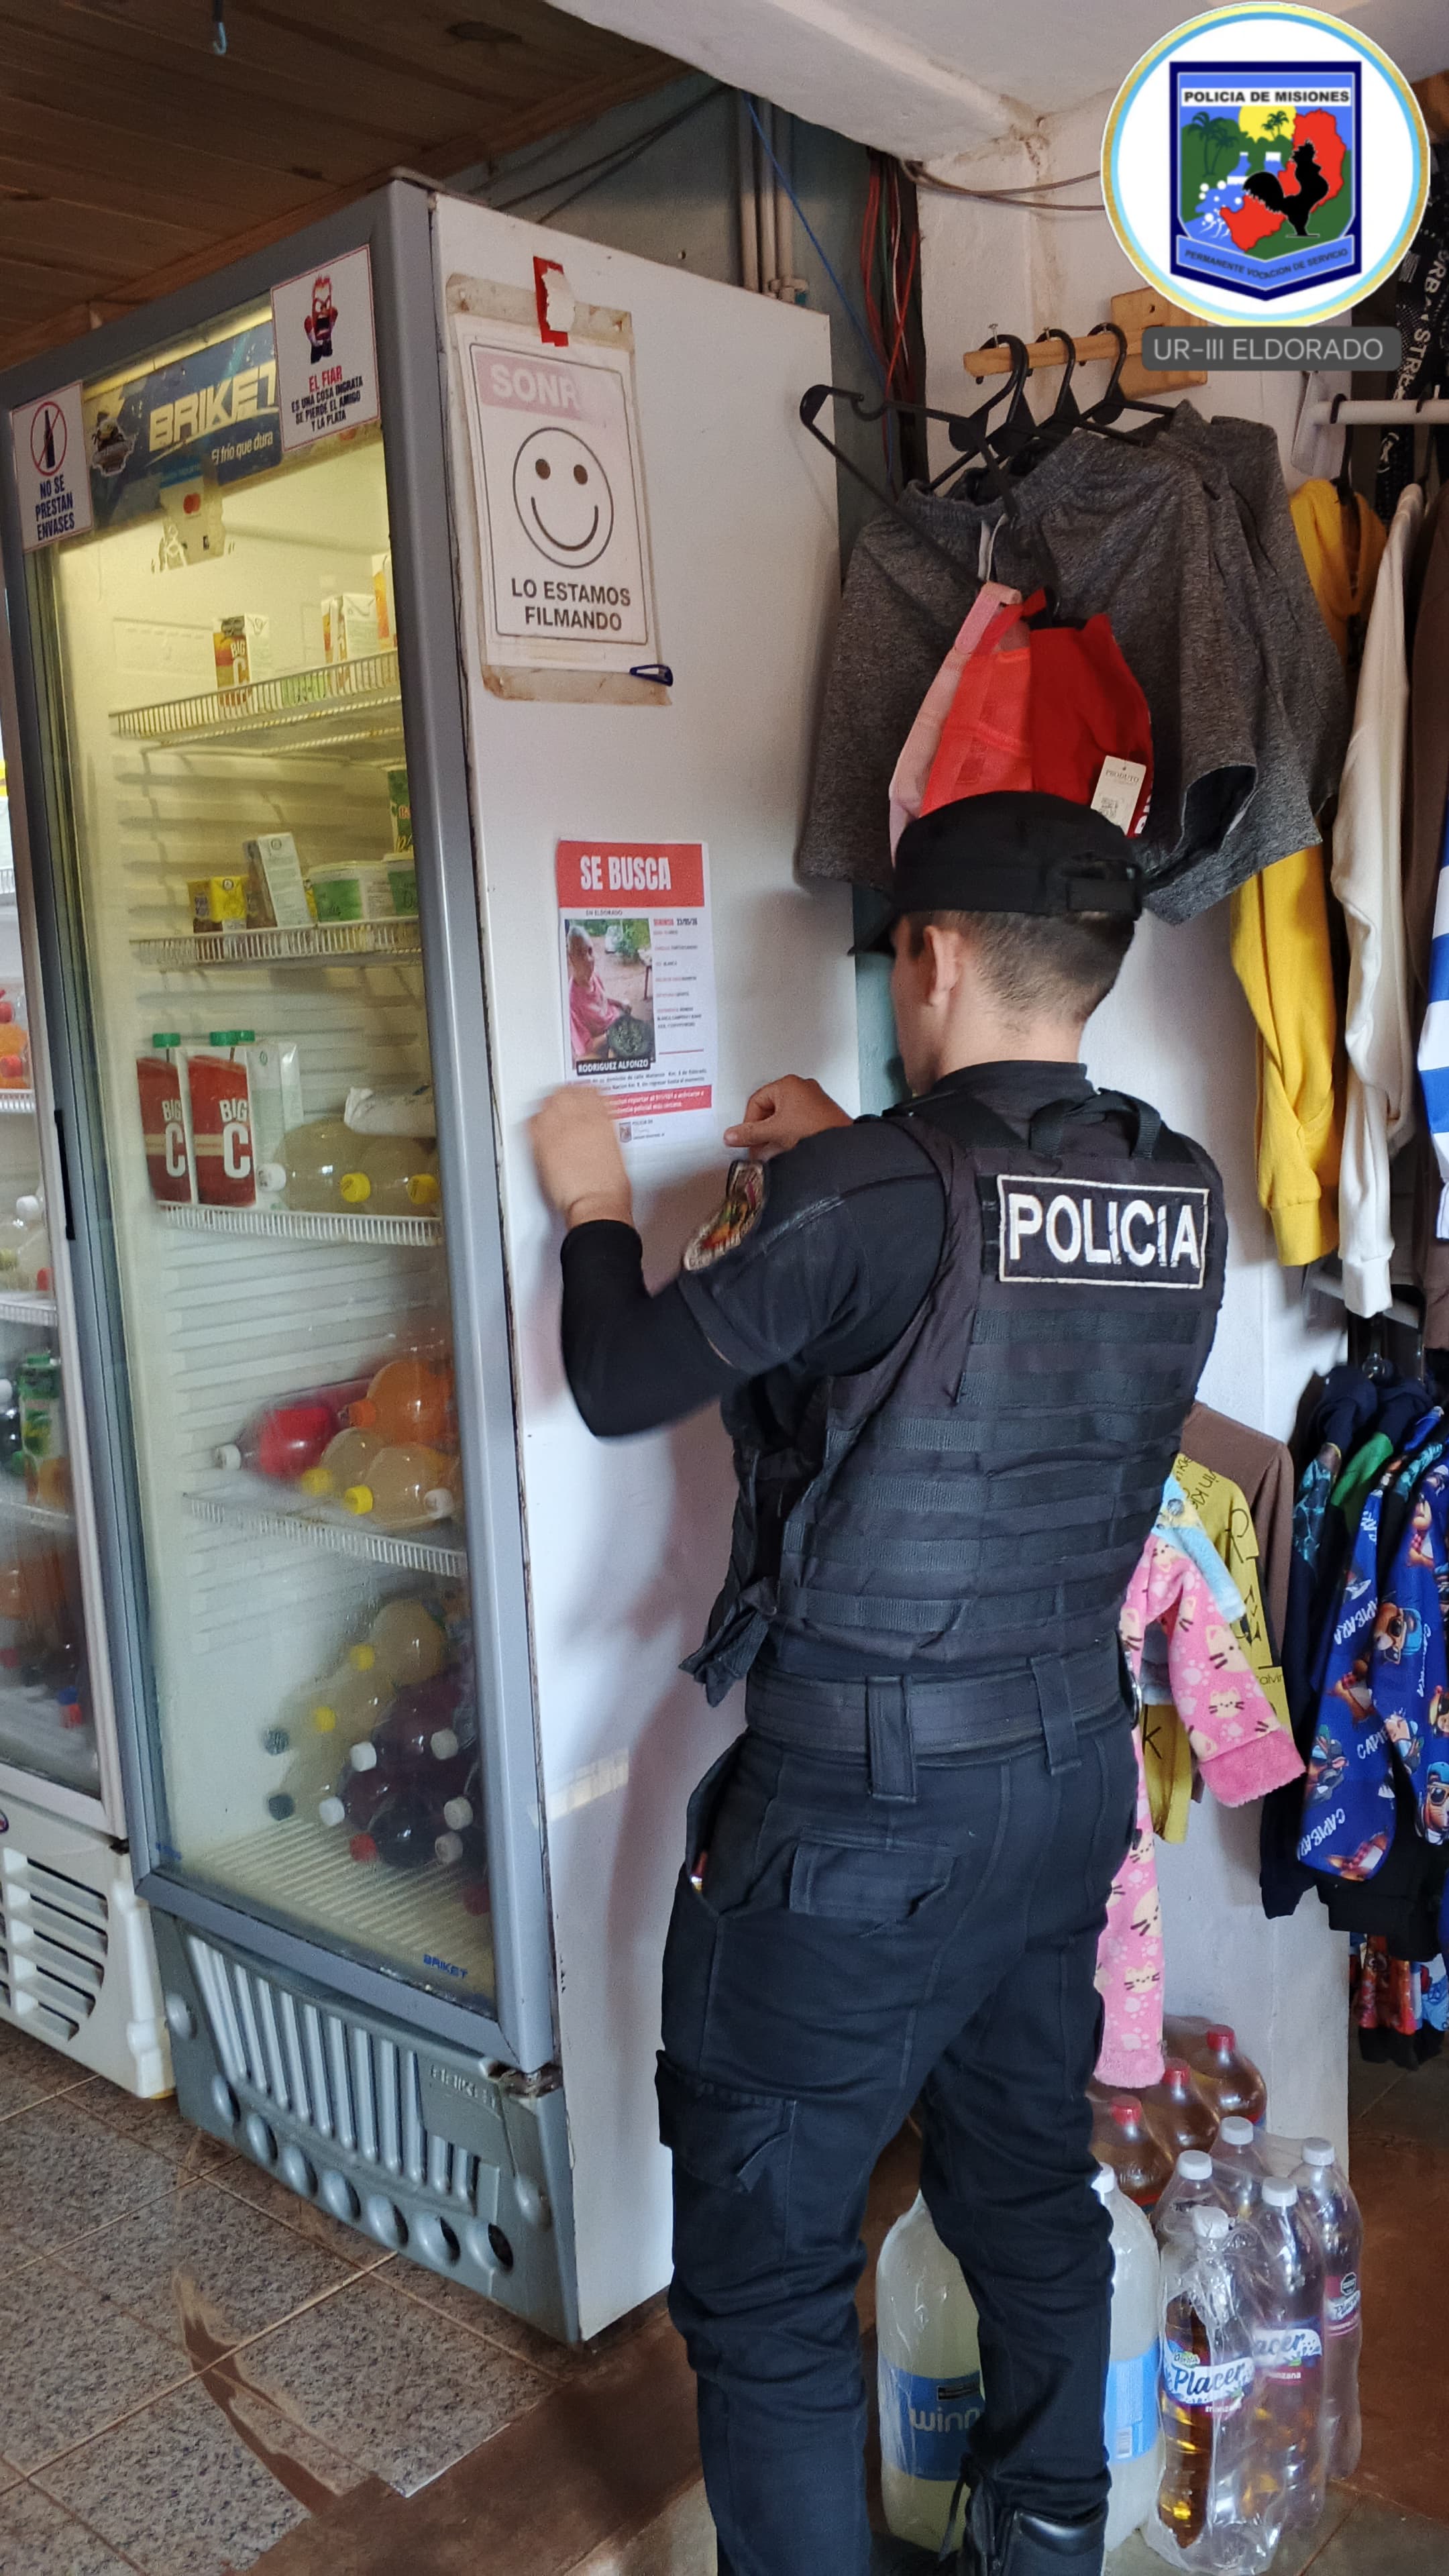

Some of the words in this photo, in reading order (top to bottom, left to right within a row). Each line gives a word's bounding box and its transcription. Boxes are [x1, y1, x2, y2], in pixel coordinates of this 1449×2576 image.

[309, 374, 320, 392] EL
[321, 365, 343, 387] FIAR
[149, 360, 277, 452] BRIKET
[291, 400, 300, 413] ES
[301, 394, 315, 409] UNA
[316, 387, 334, 404] COSA
[335, 376, 364, 394] INGRATA
[295, 412, 304, 425] SE
[305, 402, 328, 423] PIERDE
[329, 400, 337, 412] EL
[339, 390, 361, 407] AMIGO
[311, 421, 315, 432] Y
[317, 417, 325, 430] LA
[326, 410, 347, 427] PLATA
[236, 439, 252, 461] que
[254, 431, 274, 449] dura
[40, 480, 52, 500] NO
[54, 474, 65, 494] SE
[35, 492, 73, 521] PRESTAN
[37, 512, 75, 541] ENVASES
[511, 578, 537, 598] LO
[543, 580, 631, 607] ESTAMOS
[524, 605, 623, 631] FILMANDO
[580, 855, 604, 891] SE
[608, 855, 672, 892] BUSCA
[578, 1061, 617, 1073] RODRIGUEZ
[618, 1059, 649, 1070] ALFONZO
[162, 1099, 182, 1122] BIG
[219, 1097, 248, 1123] BIG
[165, 1122, 186, 1179] C
[223, 1121, 252, 1179] C
[1008, 1192, 1201, 1269] POLICIA
[1333, 1597, 1378, 1645] APIBARA
[423, 1953, 468, 1980] BRIKET
[1171, 2363, 1246, 2396] Placer
